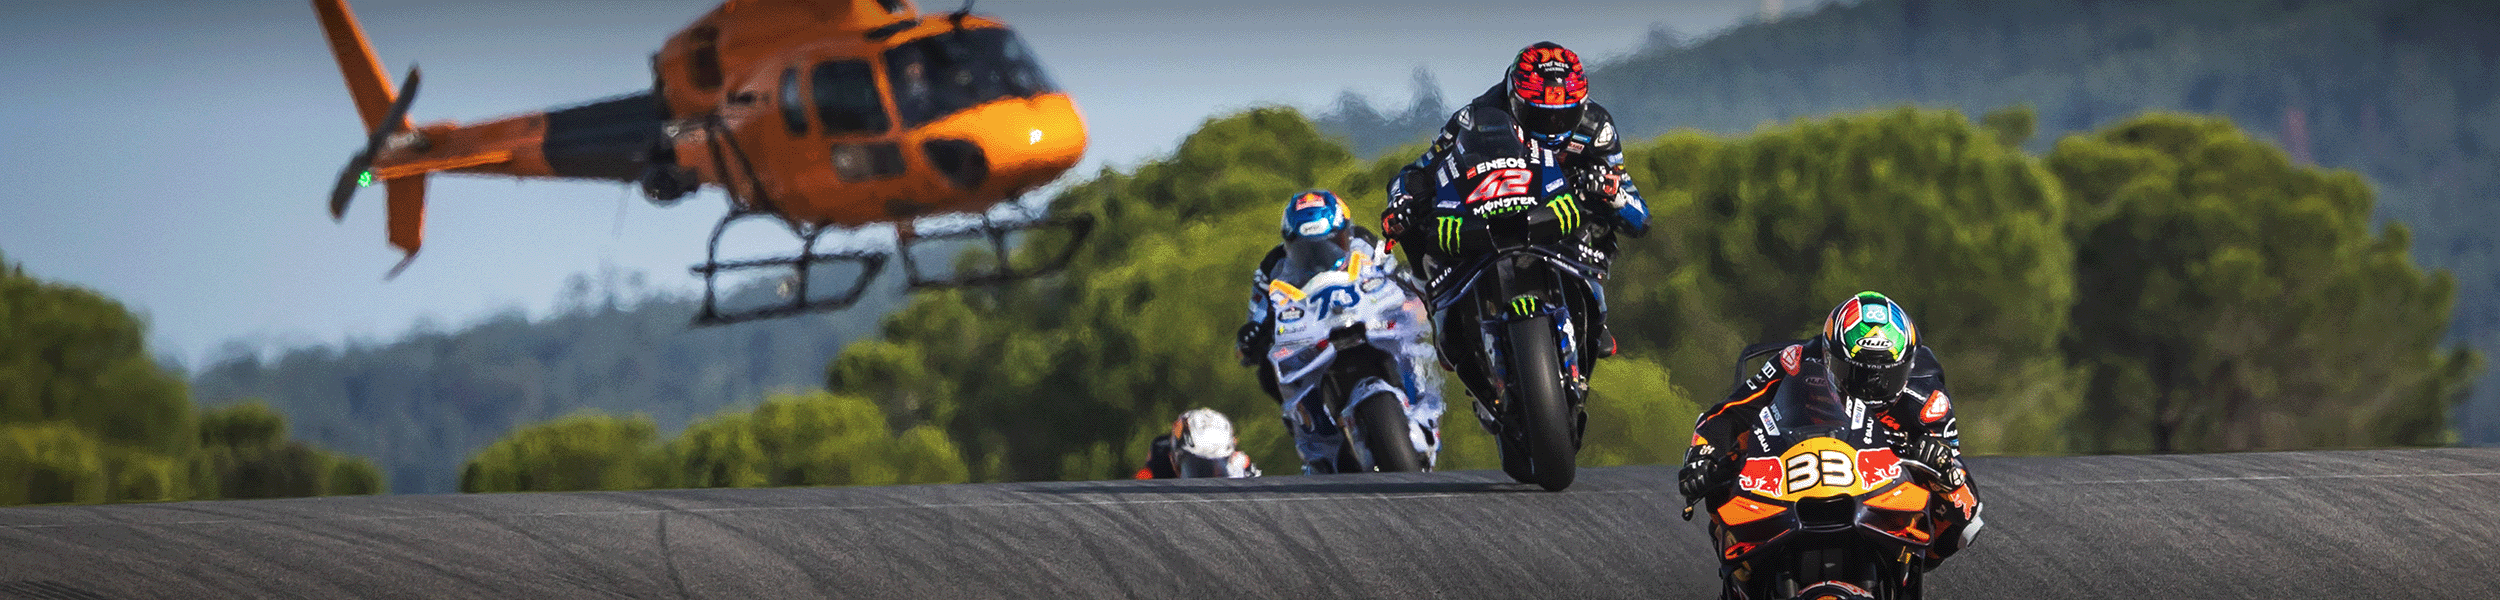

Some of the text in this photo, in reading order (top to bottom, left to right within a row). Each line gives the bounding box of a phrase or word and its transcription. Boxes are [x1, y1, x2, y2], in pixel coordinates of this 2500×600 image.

[1476, 157, 1527, 174] ENEOS
[1465, 168, 1534, 204] 42
[1473, 196, 1538, 215] MONSTER
[1861, 339, 1890, 347] HJC
[1786, 449, 1856, 494] 33
